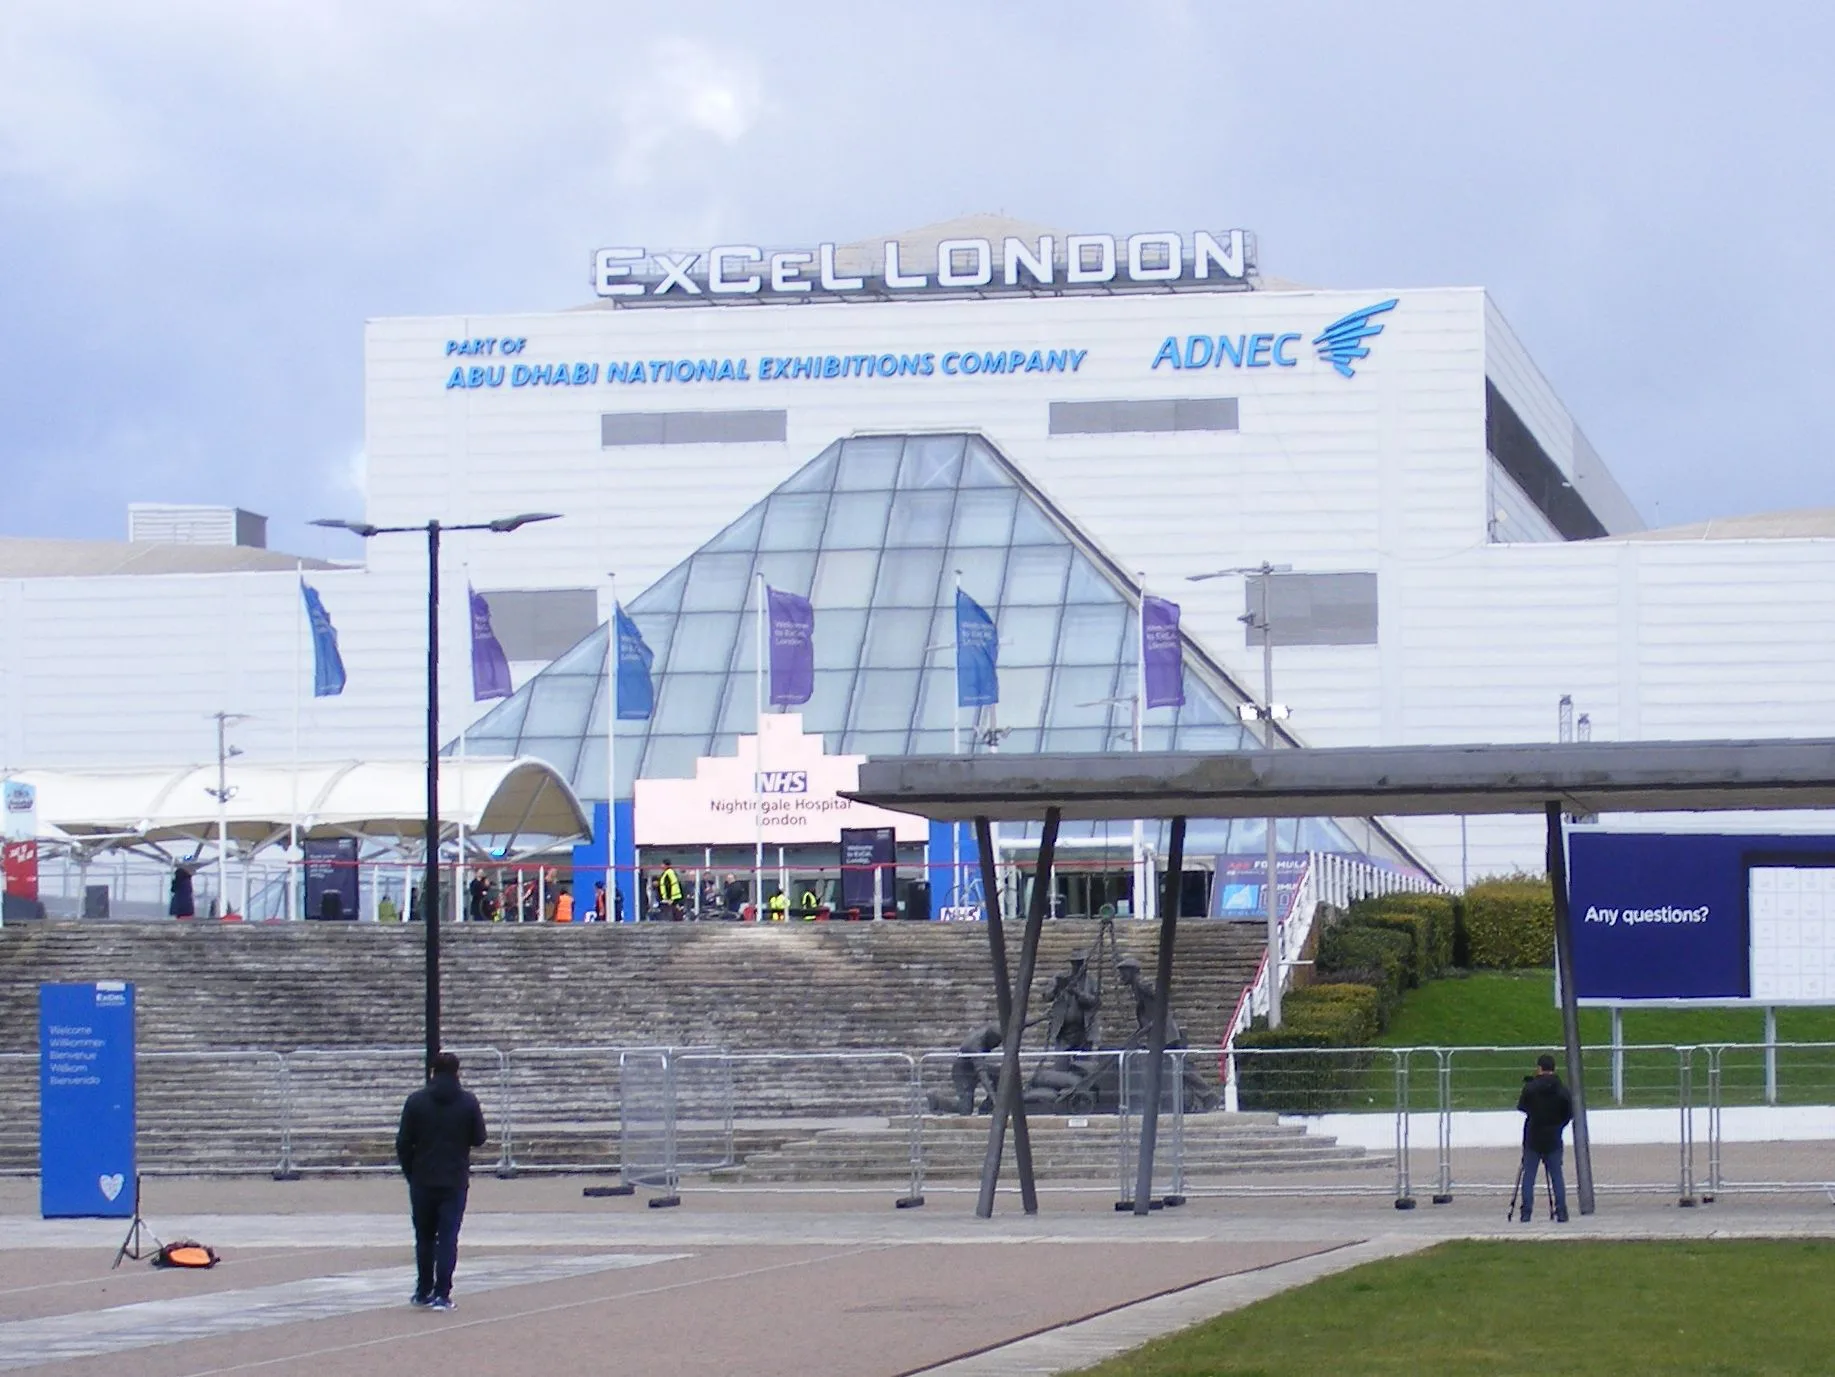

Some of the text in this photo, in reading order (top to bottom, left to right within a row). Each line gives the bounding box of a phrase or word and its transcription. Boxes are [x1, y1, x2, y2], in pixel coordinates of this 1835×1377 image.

[884, 229, 1245, 288] LONDON
[446, 336, 527, 356] PART OF
[1152, 333, 1302, 370] ADNEC
[446, 349, 1087, 389] ABU DHABI NATIONAL EXHIBITIONS COMPANY
[757, 772, 806, 792] NHS
[795, 797, 852, 813] Hospital
[756, 813, 807, 826] London
[1584, 905, 1710, 926] Any questions?
